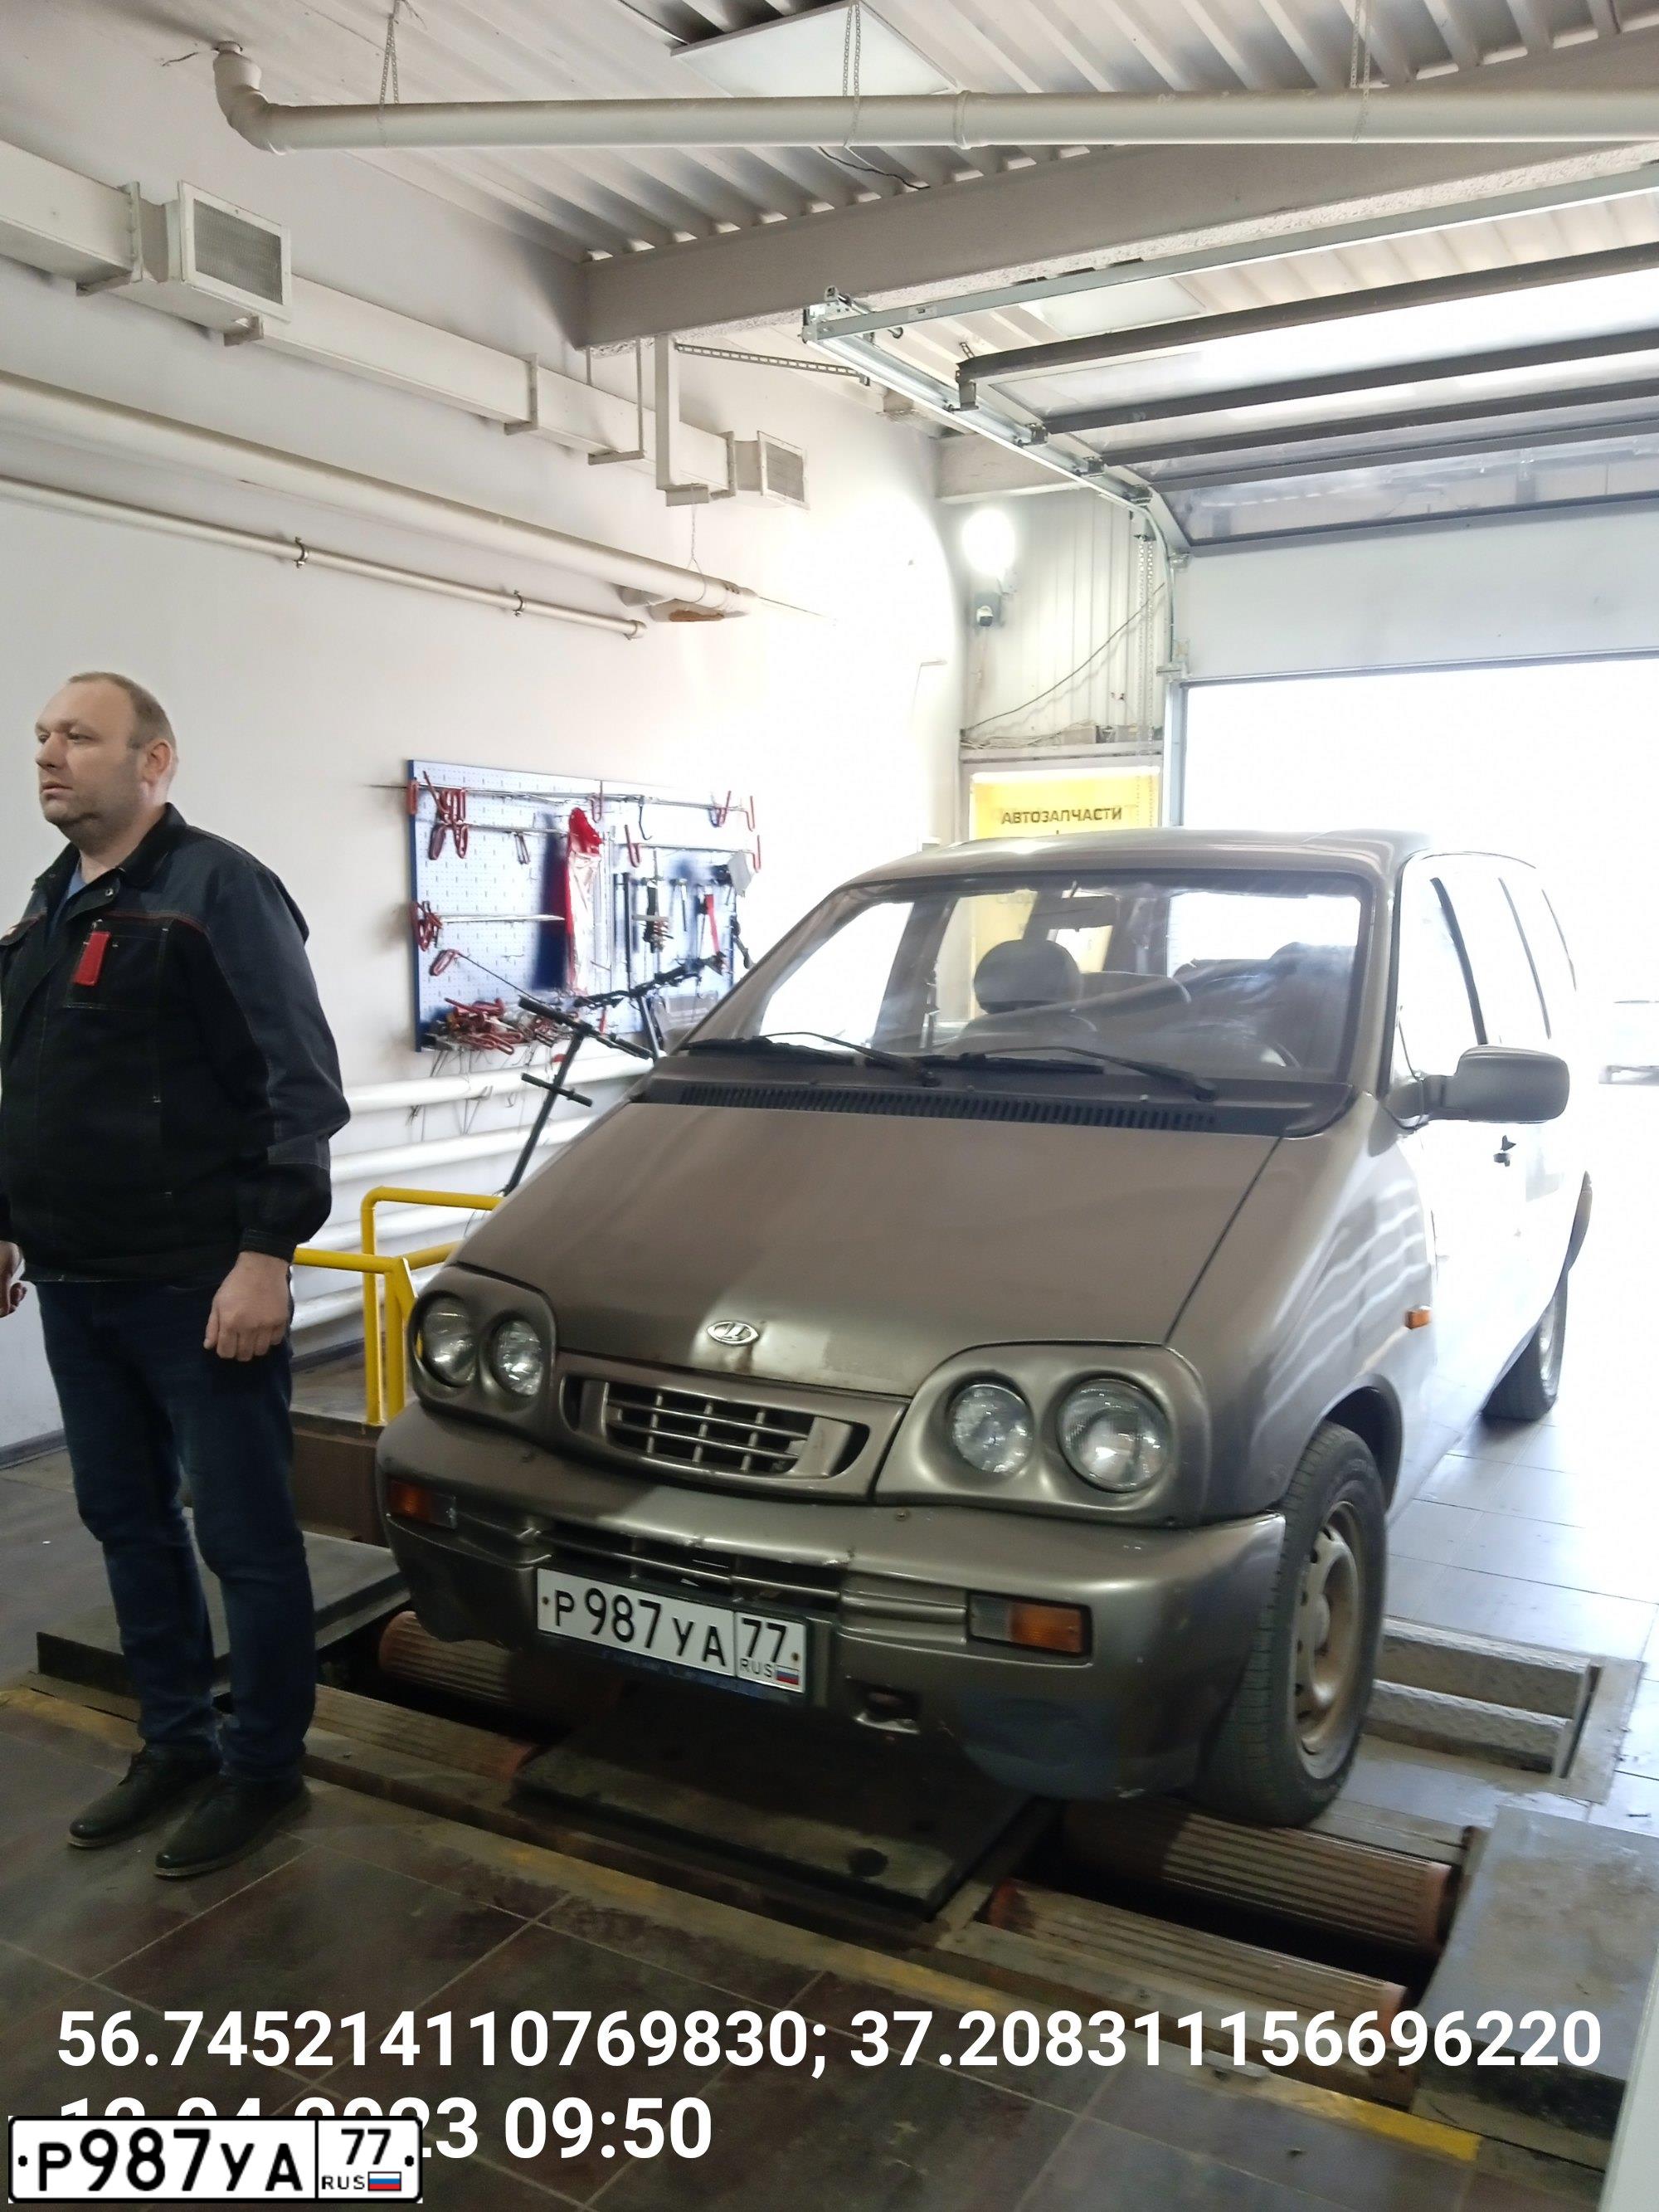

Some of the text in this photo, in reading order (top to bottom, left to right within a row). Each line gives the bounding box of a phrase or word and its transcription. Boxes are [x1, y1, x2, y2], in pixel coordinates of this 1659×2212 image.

[1001, 807, 1122, 824] АВТОЗАПЧАСТИ
[554, 1587, 787, 1667] Р987УА 77
[739, 1659, 773, 1678] RUS
